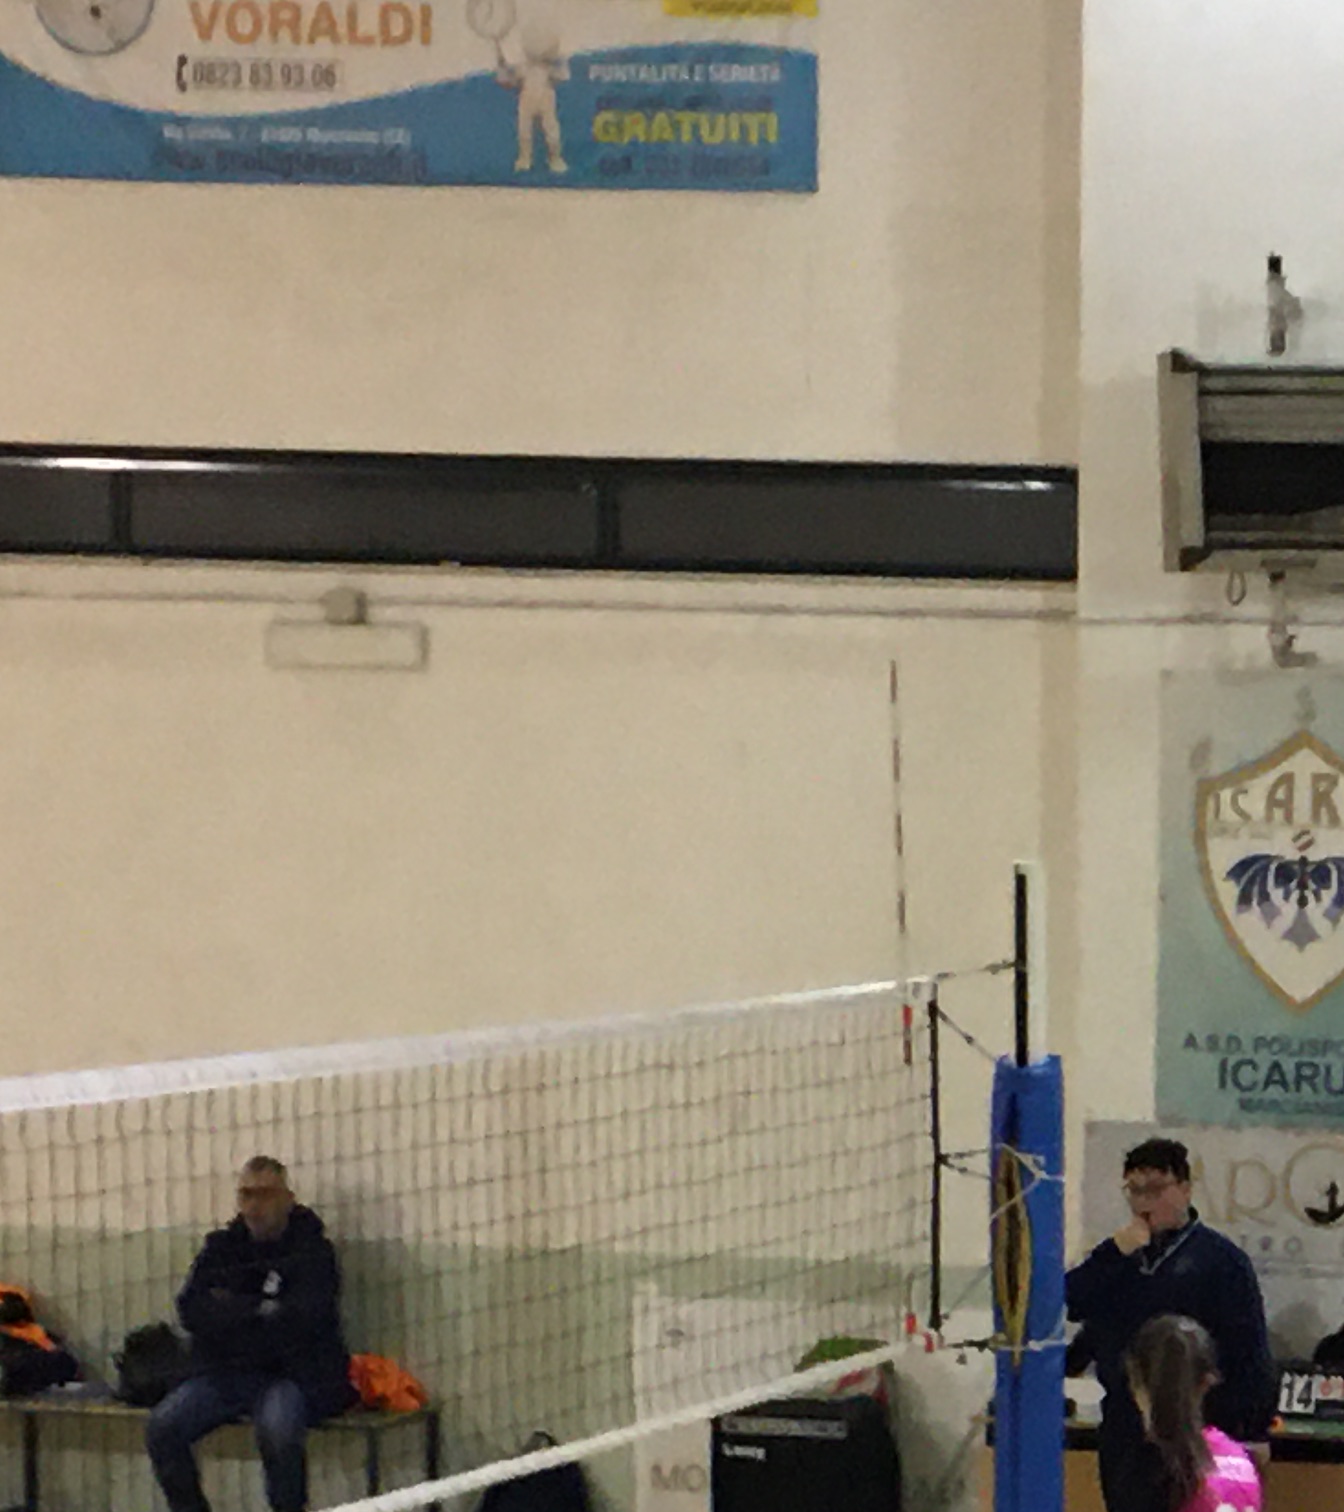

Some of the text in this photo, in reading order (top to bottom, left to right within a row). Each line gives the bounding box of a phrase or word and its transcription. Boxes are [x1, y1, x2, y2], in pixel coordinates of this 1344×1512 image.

[188, 0, 432, 46] VORALDI
[280, 63, 305, 88] 93
[311, 64, 337, 89] 06
[593, 109, 778, 145] GRATUITI
[1183, 1033, 1246, 1056] A.S.D.
